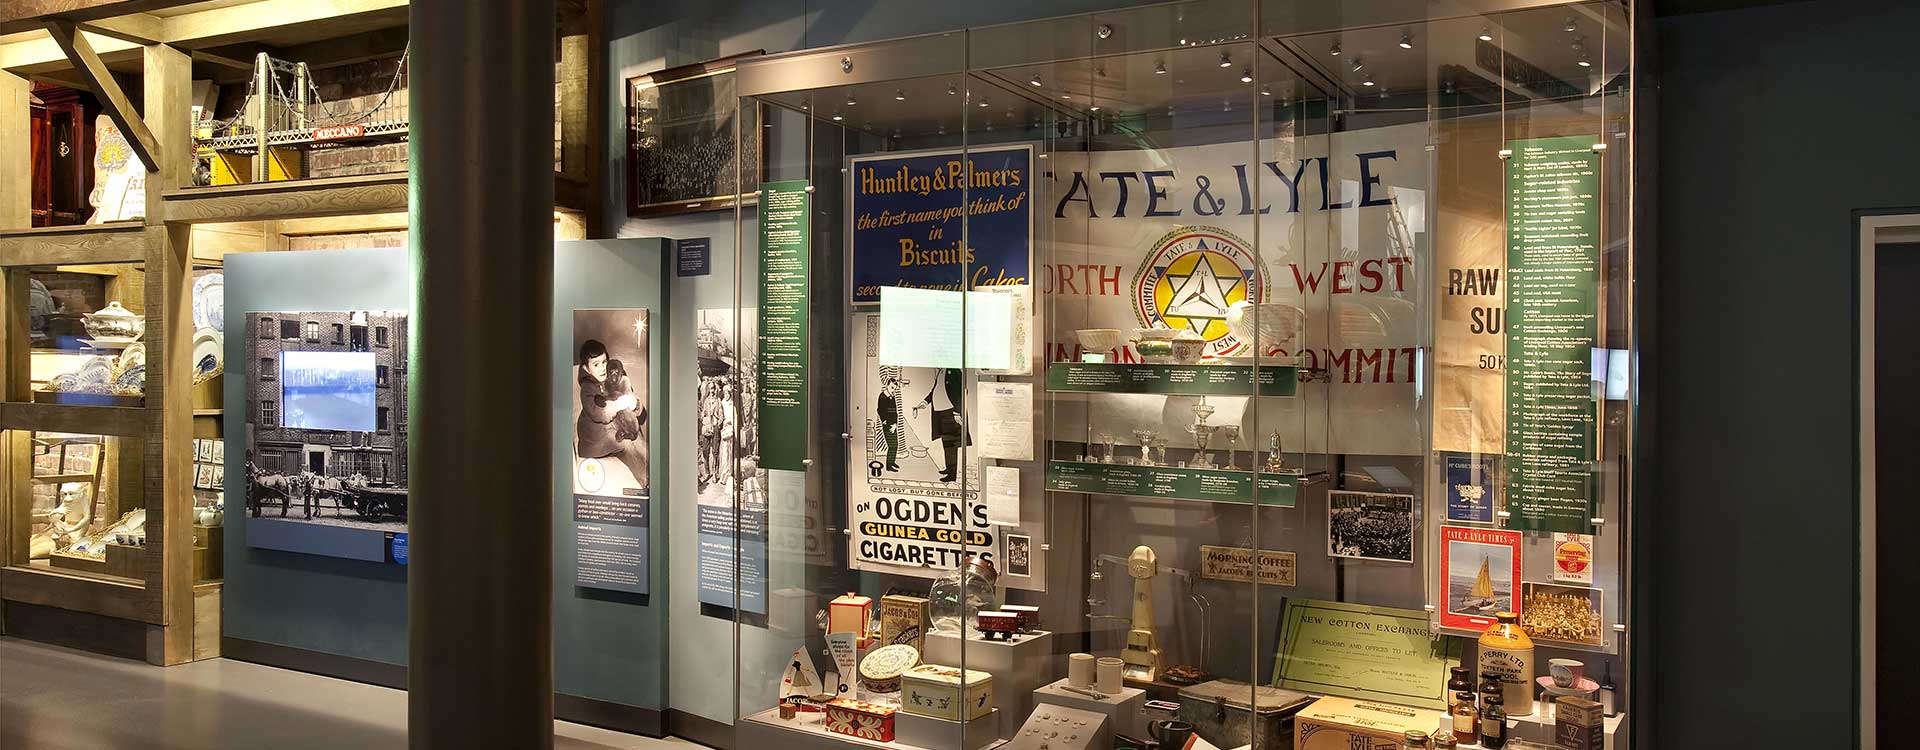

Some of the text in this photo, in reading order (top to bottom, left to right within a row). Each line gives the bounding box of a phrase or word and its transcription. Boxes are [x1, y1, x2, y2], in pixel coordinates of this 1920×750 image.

[316, 126, 360, 139] MECCANO
[861, 160, 1022, 196] Huntley & Palmers
[1191, 174, 1226, 217] &
[1231, 150, 1398, 216] LYLE
[857, 191, 1026, 231] the first name you think of
[928, 225, 944, 241] in
[898, 238, 976, 268] Biscuits
[1163, 242, 1185, 261] TATE
[1215, 241, 1241, 260] LYLE
[1043, 257, 1413, 297] ORTH WEST
[1449, 268, 1499, 296] RAW
[857, 278, 904, 297] seco
[1470, 306, 1502, 335] SU
[1213, 336, 1237, 352] WEST
[1479, 354, 1496, 370] 50
[857, 497, 991, 528] ON OGDEN'S
[864, 522, 986, 545] GUINEA GOLD
[1448, 530, 1463, 540] TATE
[1470, 532, 1486, 541] LYLE
[1488, 534, 1507, 544] TIMES
[1207, 552, 1253, 564] MORNING
[1257, 555, 1292, 568] COFFEE
[1246, 570, 1278, 579] BICUITS
[1300, 615, 1324, 625] NEW
[1328, 618, 1371, 630] COTTON
[1312, 638, 1346, 648] SALEROOMS
[1484, 650, 1508, 659] PERRY
[1350, 733, 1372, 744] TATE
